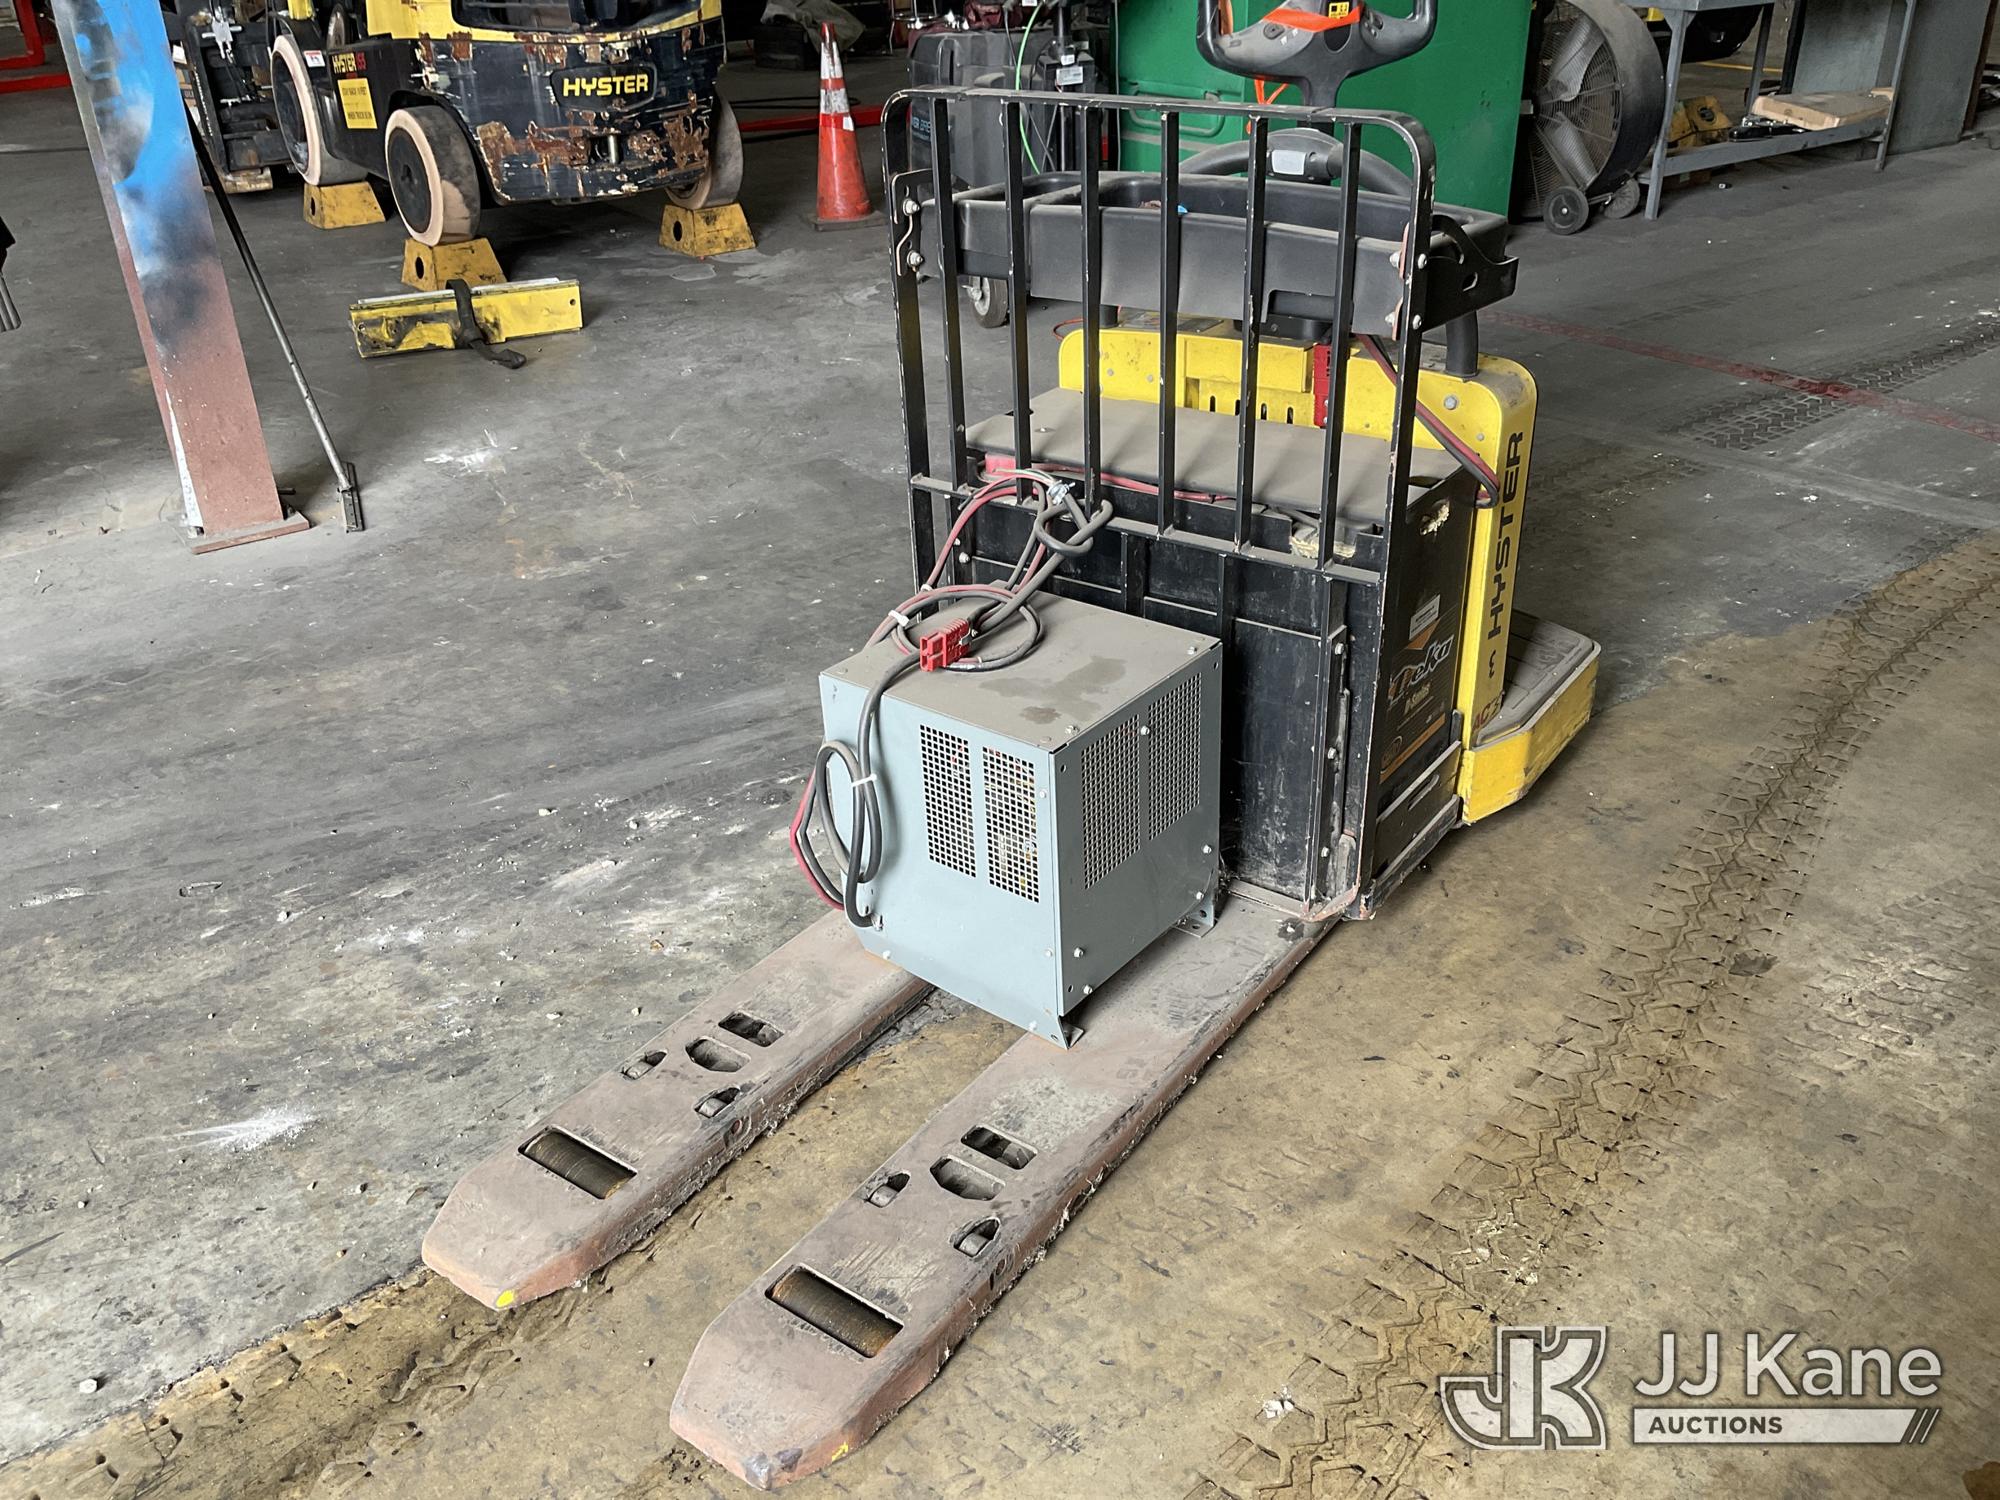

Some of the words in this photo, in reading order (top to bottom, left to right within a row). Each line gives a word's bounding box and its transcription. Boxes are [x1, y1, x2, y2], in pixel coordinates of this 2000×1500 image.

[332, 53, 357, 74] HYSTER
[563, 74, 649, 97] HYSTER
[1488, 431, 1524, 640] HYSTER
